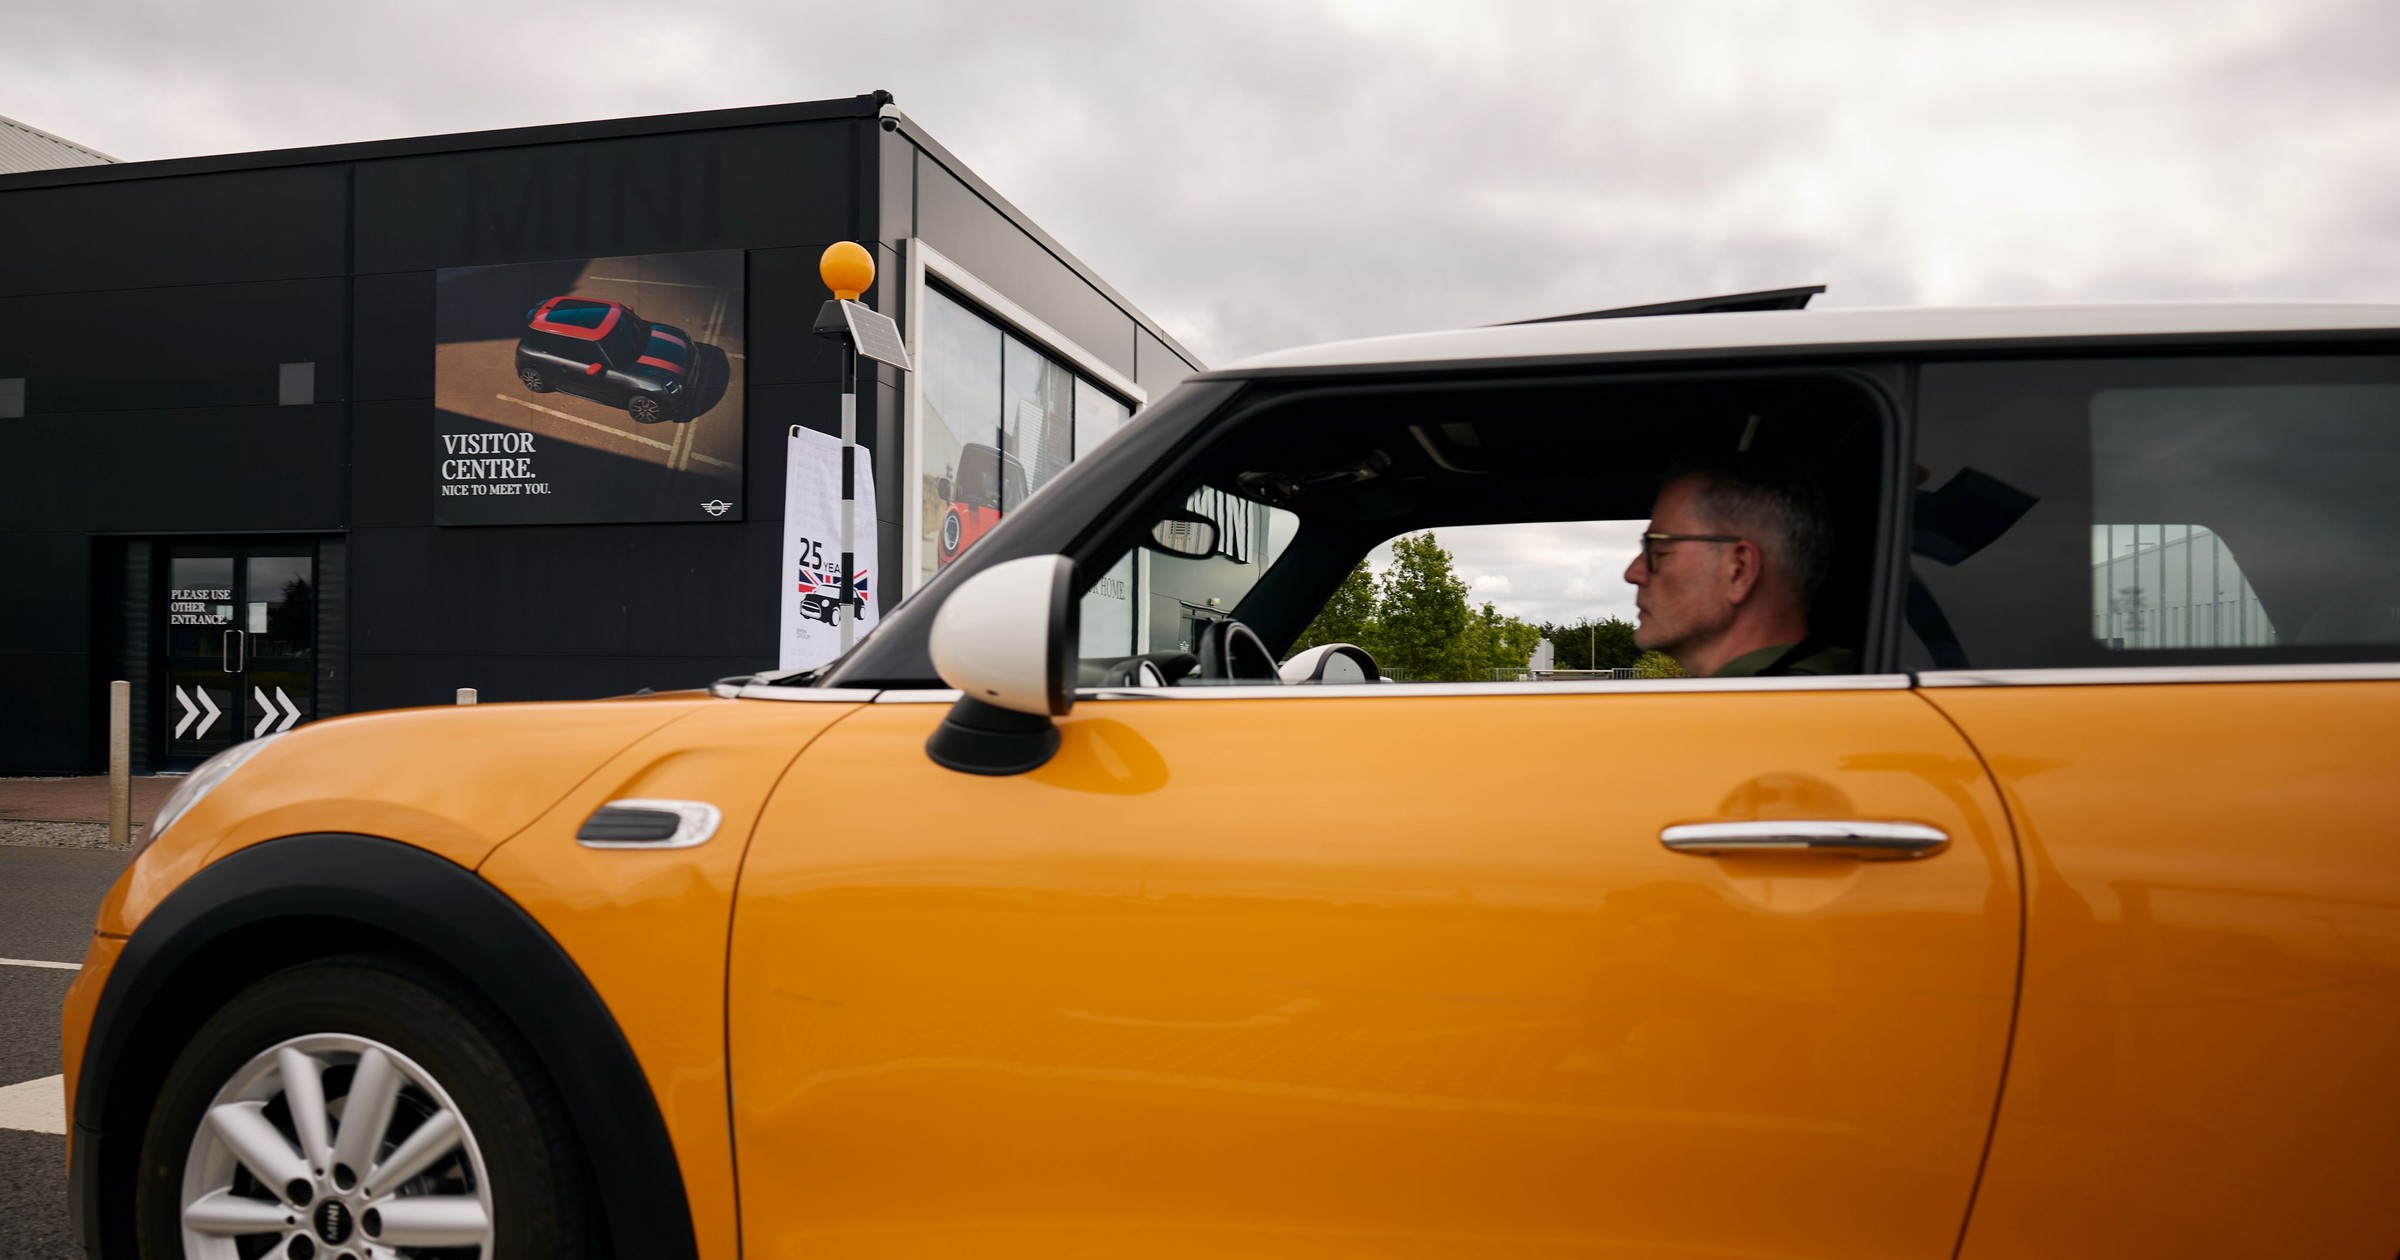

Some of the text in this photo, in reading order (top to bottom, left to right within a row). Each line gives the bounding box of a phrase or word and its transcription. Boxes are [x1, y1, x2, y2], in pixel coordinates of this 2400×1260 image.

[461, 143, 722, 261] MINI
[442, 433, 536, 454] VISITOR
[442, 458, 536, 480] CENTRE.
[442, 483, 551, 496] NICE TO MEET YOU.
[799, 537, 841, 574] 25 YEA
[171, 590, 231, 599] PLEASE USE
[171, 602, 206, 612] OTHER
[171, 615, 227, 624] ENTRANCE.
[327, 1204, 340, 1240] MINI
